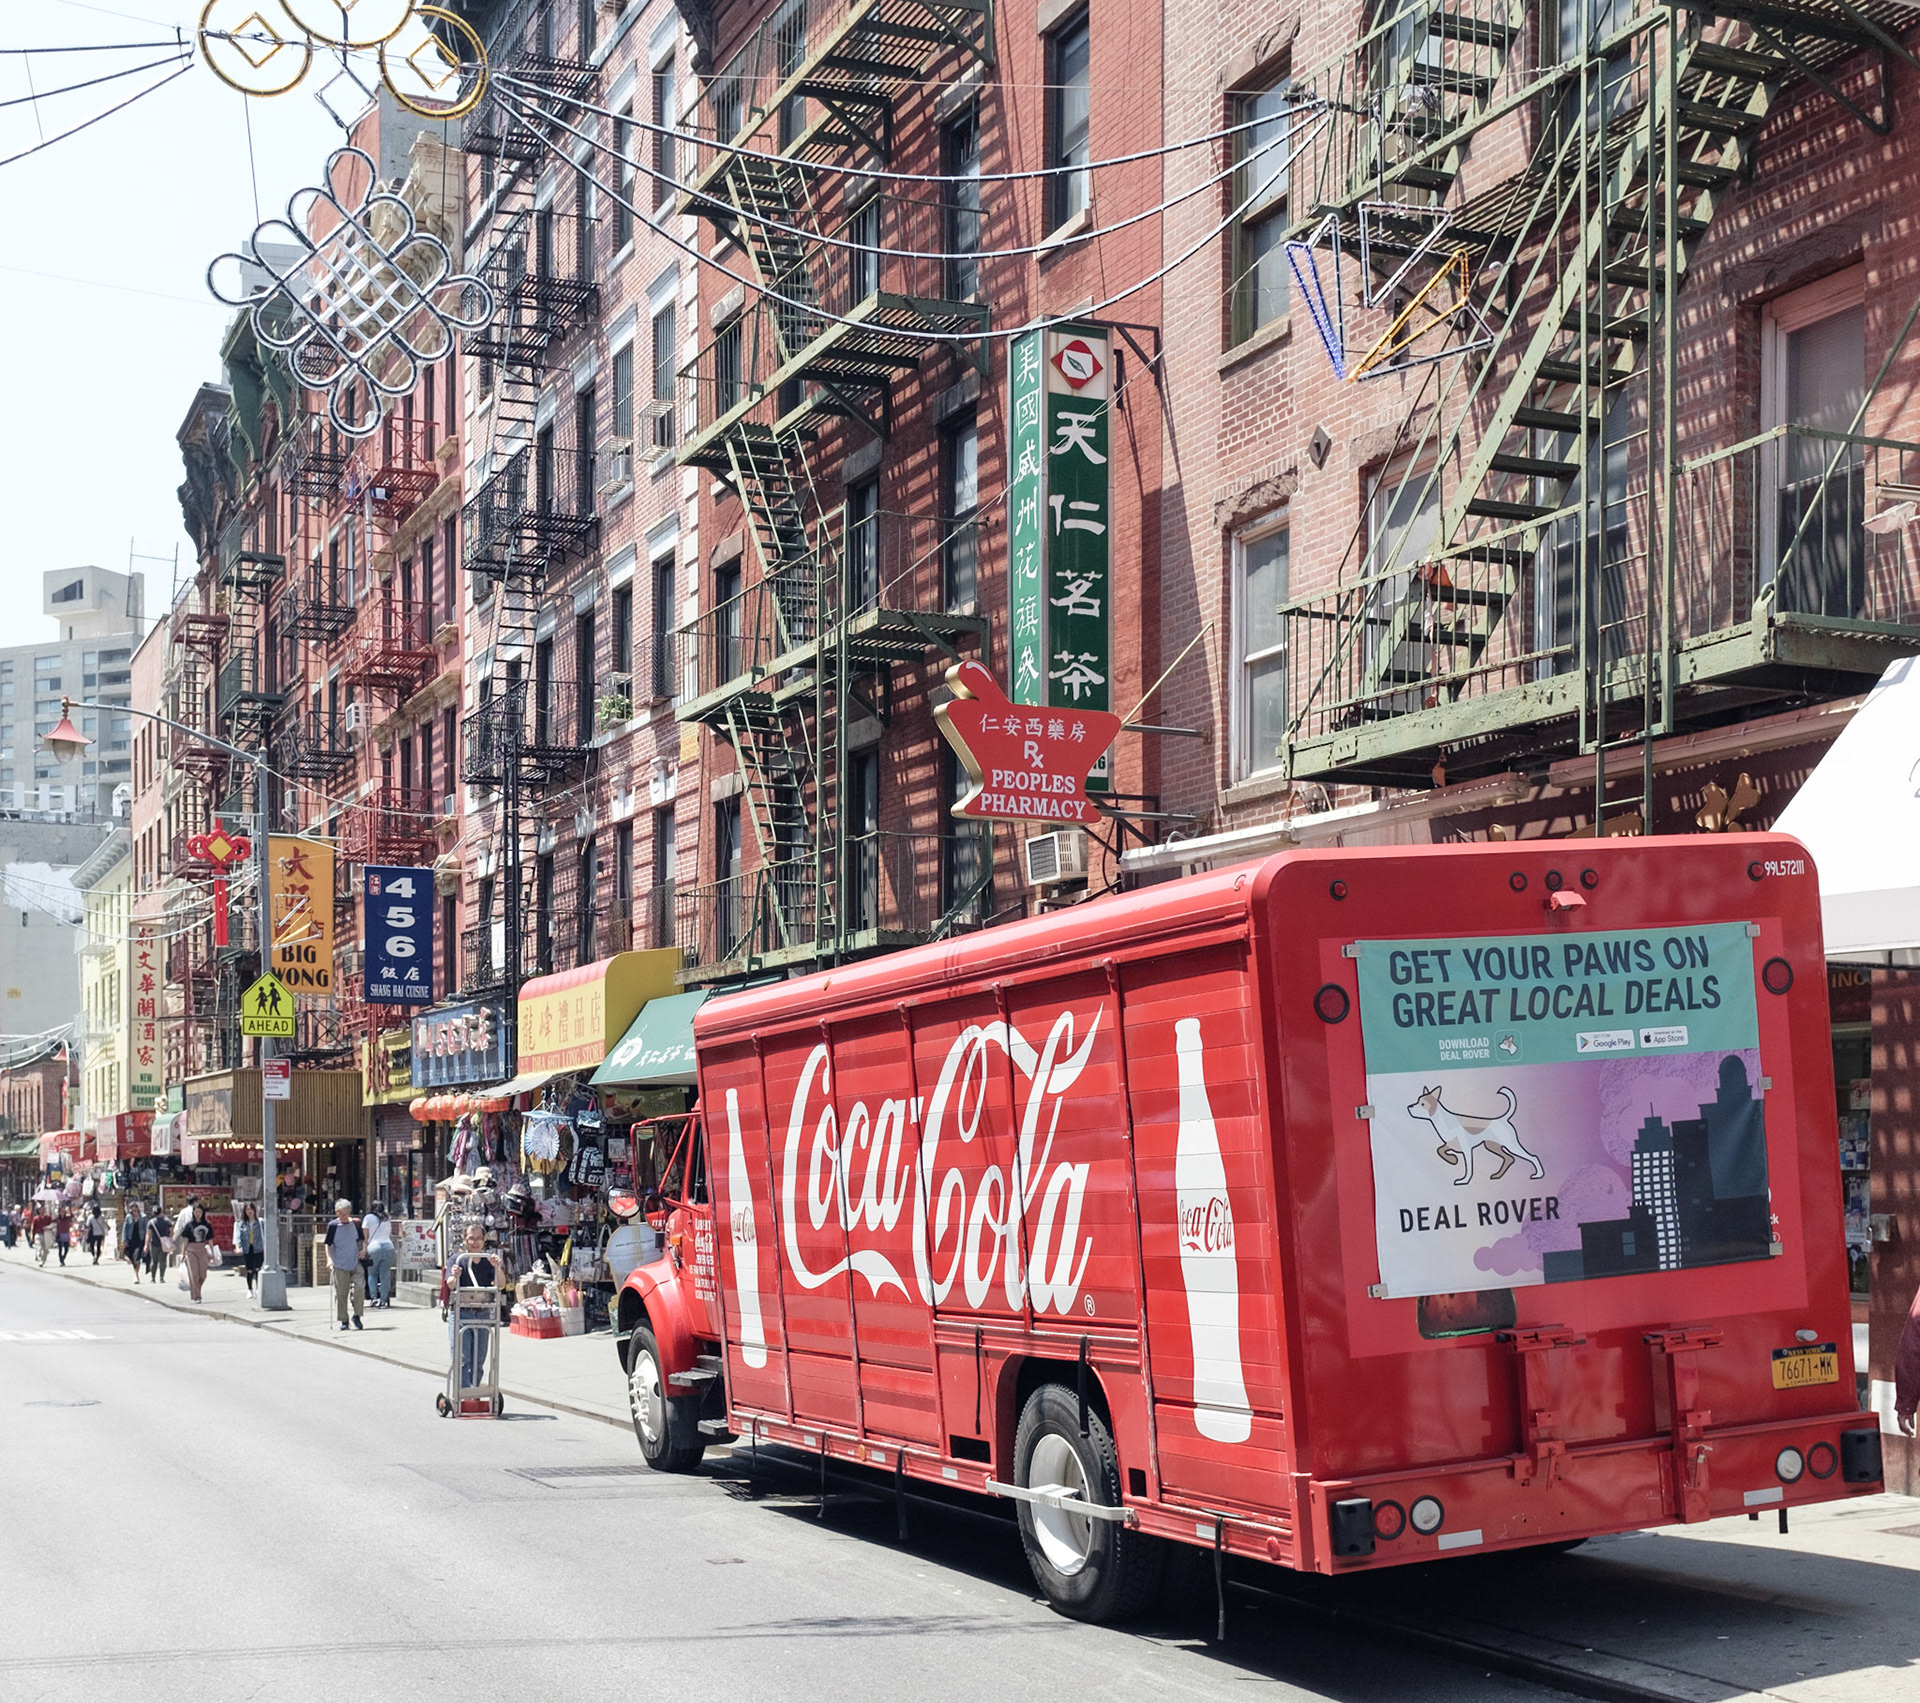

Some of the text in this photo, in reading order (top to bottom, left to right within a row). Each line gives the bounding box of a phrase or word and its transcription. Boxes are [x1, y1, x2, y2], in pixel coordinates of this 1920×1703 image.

[1048, 411, 1108, 700] 天仁茗茶
[979, 713, 1086, 743] 仁安西藥房
[991, 769, 1076, 794] PEOPLES
[980, 793, 1086, 819] PHARMACY
[281, 945, 317, 963] BIG
[1389, 935, 1709, 985] GET YOUR PAWS ON
[380, 966, 419, 981] 飯店
[370, 984, 429, 998] SHANG HAI CUISINE
[1392, 975, 1721, 1028] GREAT LOCAL DEALS
[248, 1020, 289, 1032] AHEAD
[1439, 1037, 1489, 1050] DOWNLOAD
[1593, 1037, 1632, 1049] Google Play
[1653, 1034, 1685, 1045] App Store
[1440, 1049, 1490, 1060] DEAL ROVER
[140, 1073, 152, 1082] NEW
[132, 1085, 160, 1094] MANDARIN
[782, 1007, 1103, 1315] Coca-Cola
[1399, 1196, 1560, 1232] DEAL ROVER
[1180, 1197, 1232, 1253] Coca-Cola
[1788, 1349, 1804, 1357] NEW
